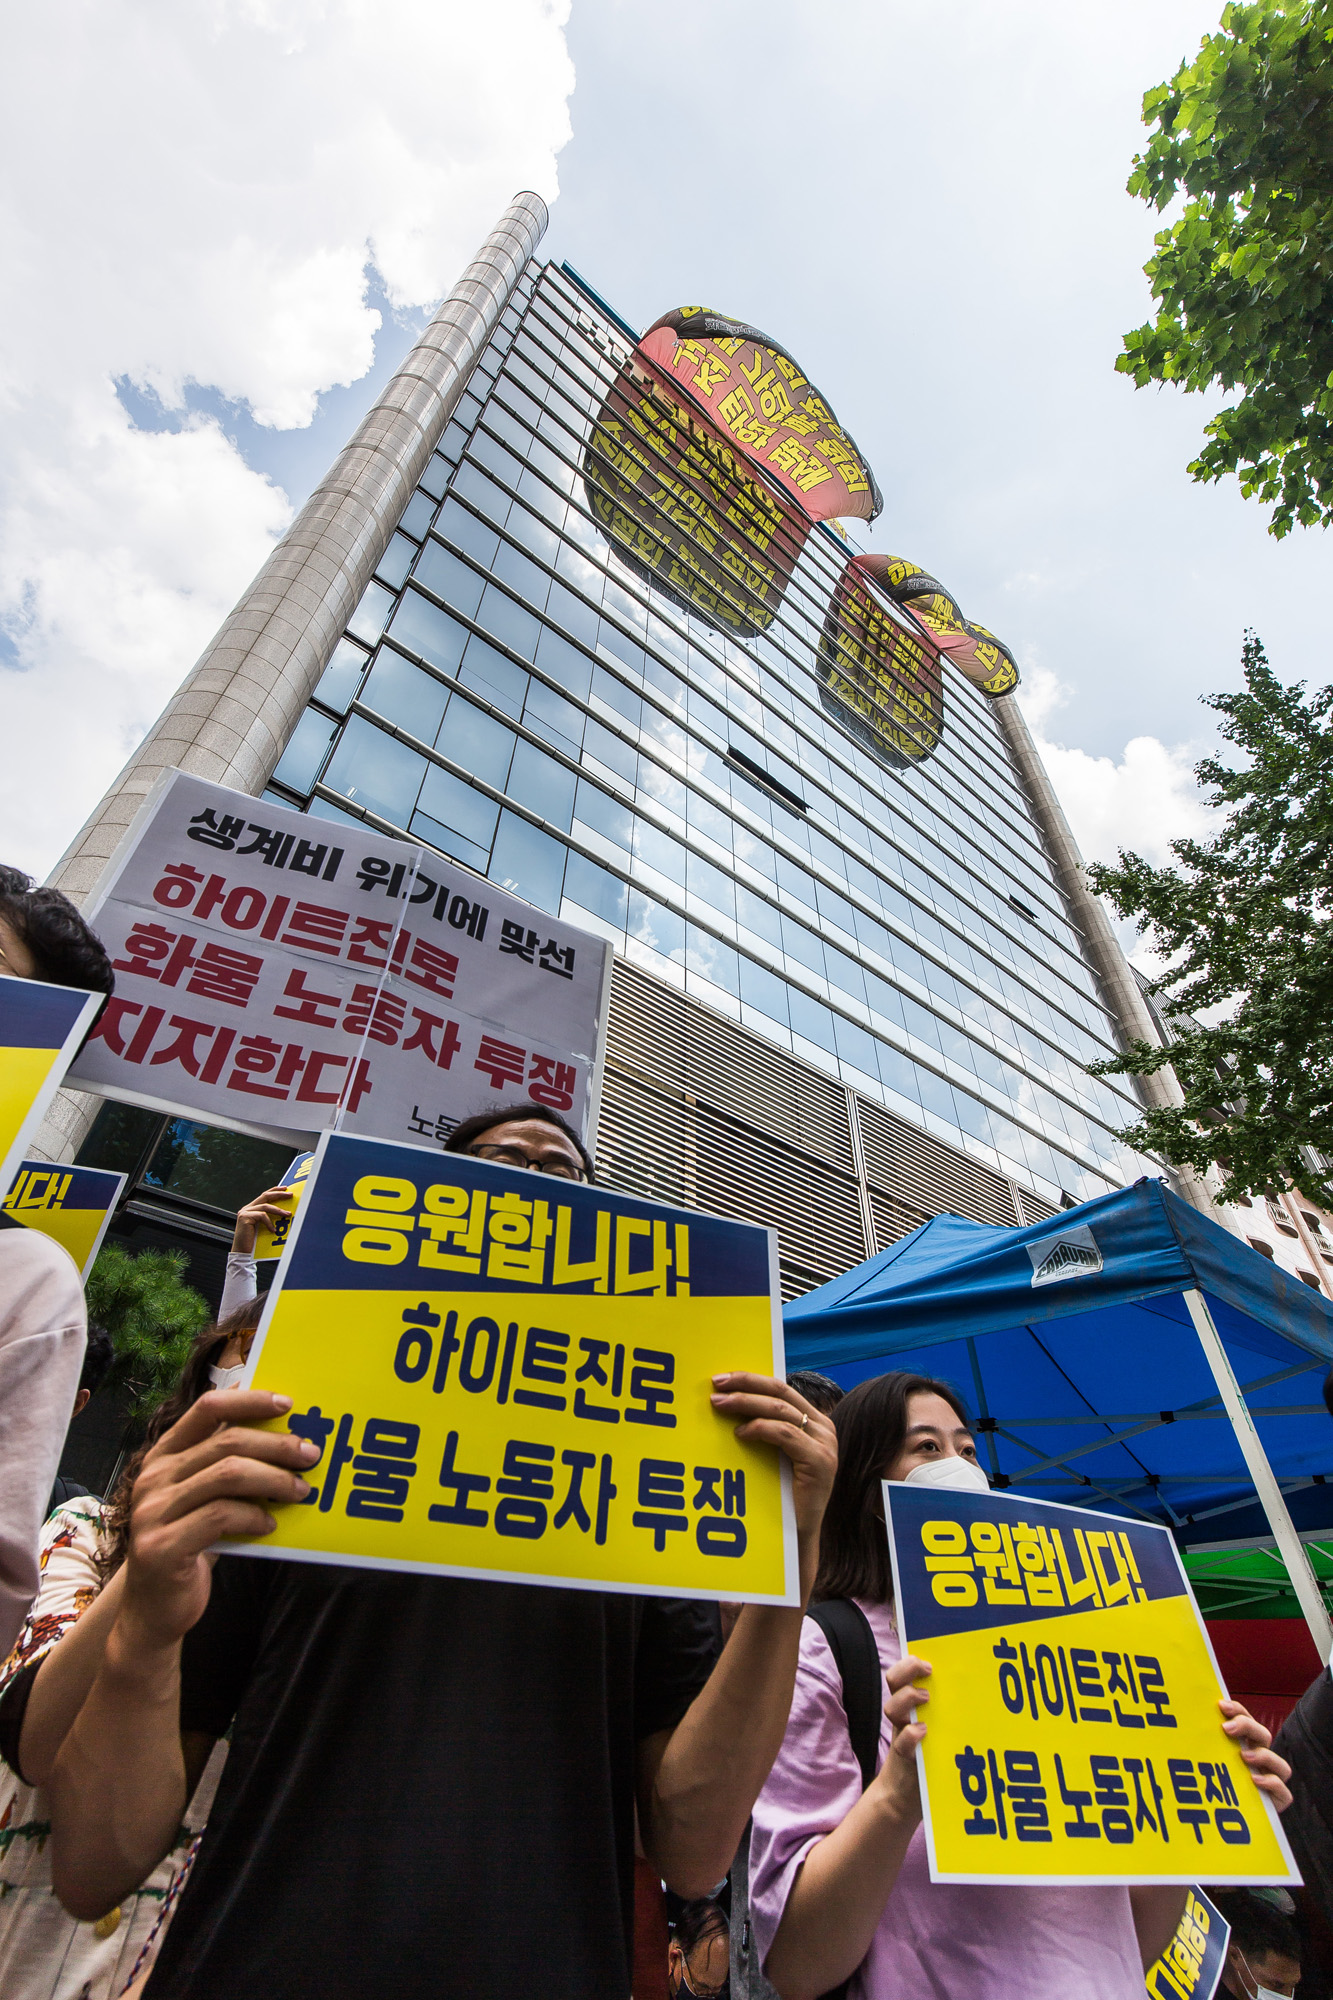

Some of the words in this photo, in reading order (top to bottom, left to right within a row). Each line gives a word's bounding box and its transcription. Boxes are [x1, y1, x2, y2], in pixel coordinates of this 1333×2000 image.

[151, 862, 460, 999] 하이트진로
[186, 807, 345, 882] 생계비
[356, 856, 490, 942] 위기에
[498, 918, 577, 981] 맞선
[90, 997, 373, 1114] 지지한다
[112, 922, 264, 1007] 화물
[273, 969, 461, 1070] 노동자
[473, 1034, 577, 1111] 투쟁
[342, 1175, 691, 1297] 응원합니다!
[1036, 1244, 1099, 1278] CARAVAN
[393, 1301, 678, 1428] 하이트진로
[287, 1405, 421, 1523] 화물
[427, 1430, 618, 1546] 노동자
[632, 1457, 748, 1559] 투쟁
[920, 1520, 1150, 1608] 응원합니다!
[992, 1636, 1178, 1729] 하이트진로
[954, 1745, 1053, 1842] 화물
[1053, 1752, 1170, 1844] 노동자
[1167, 1758, 1251, 1845] 투쟁
